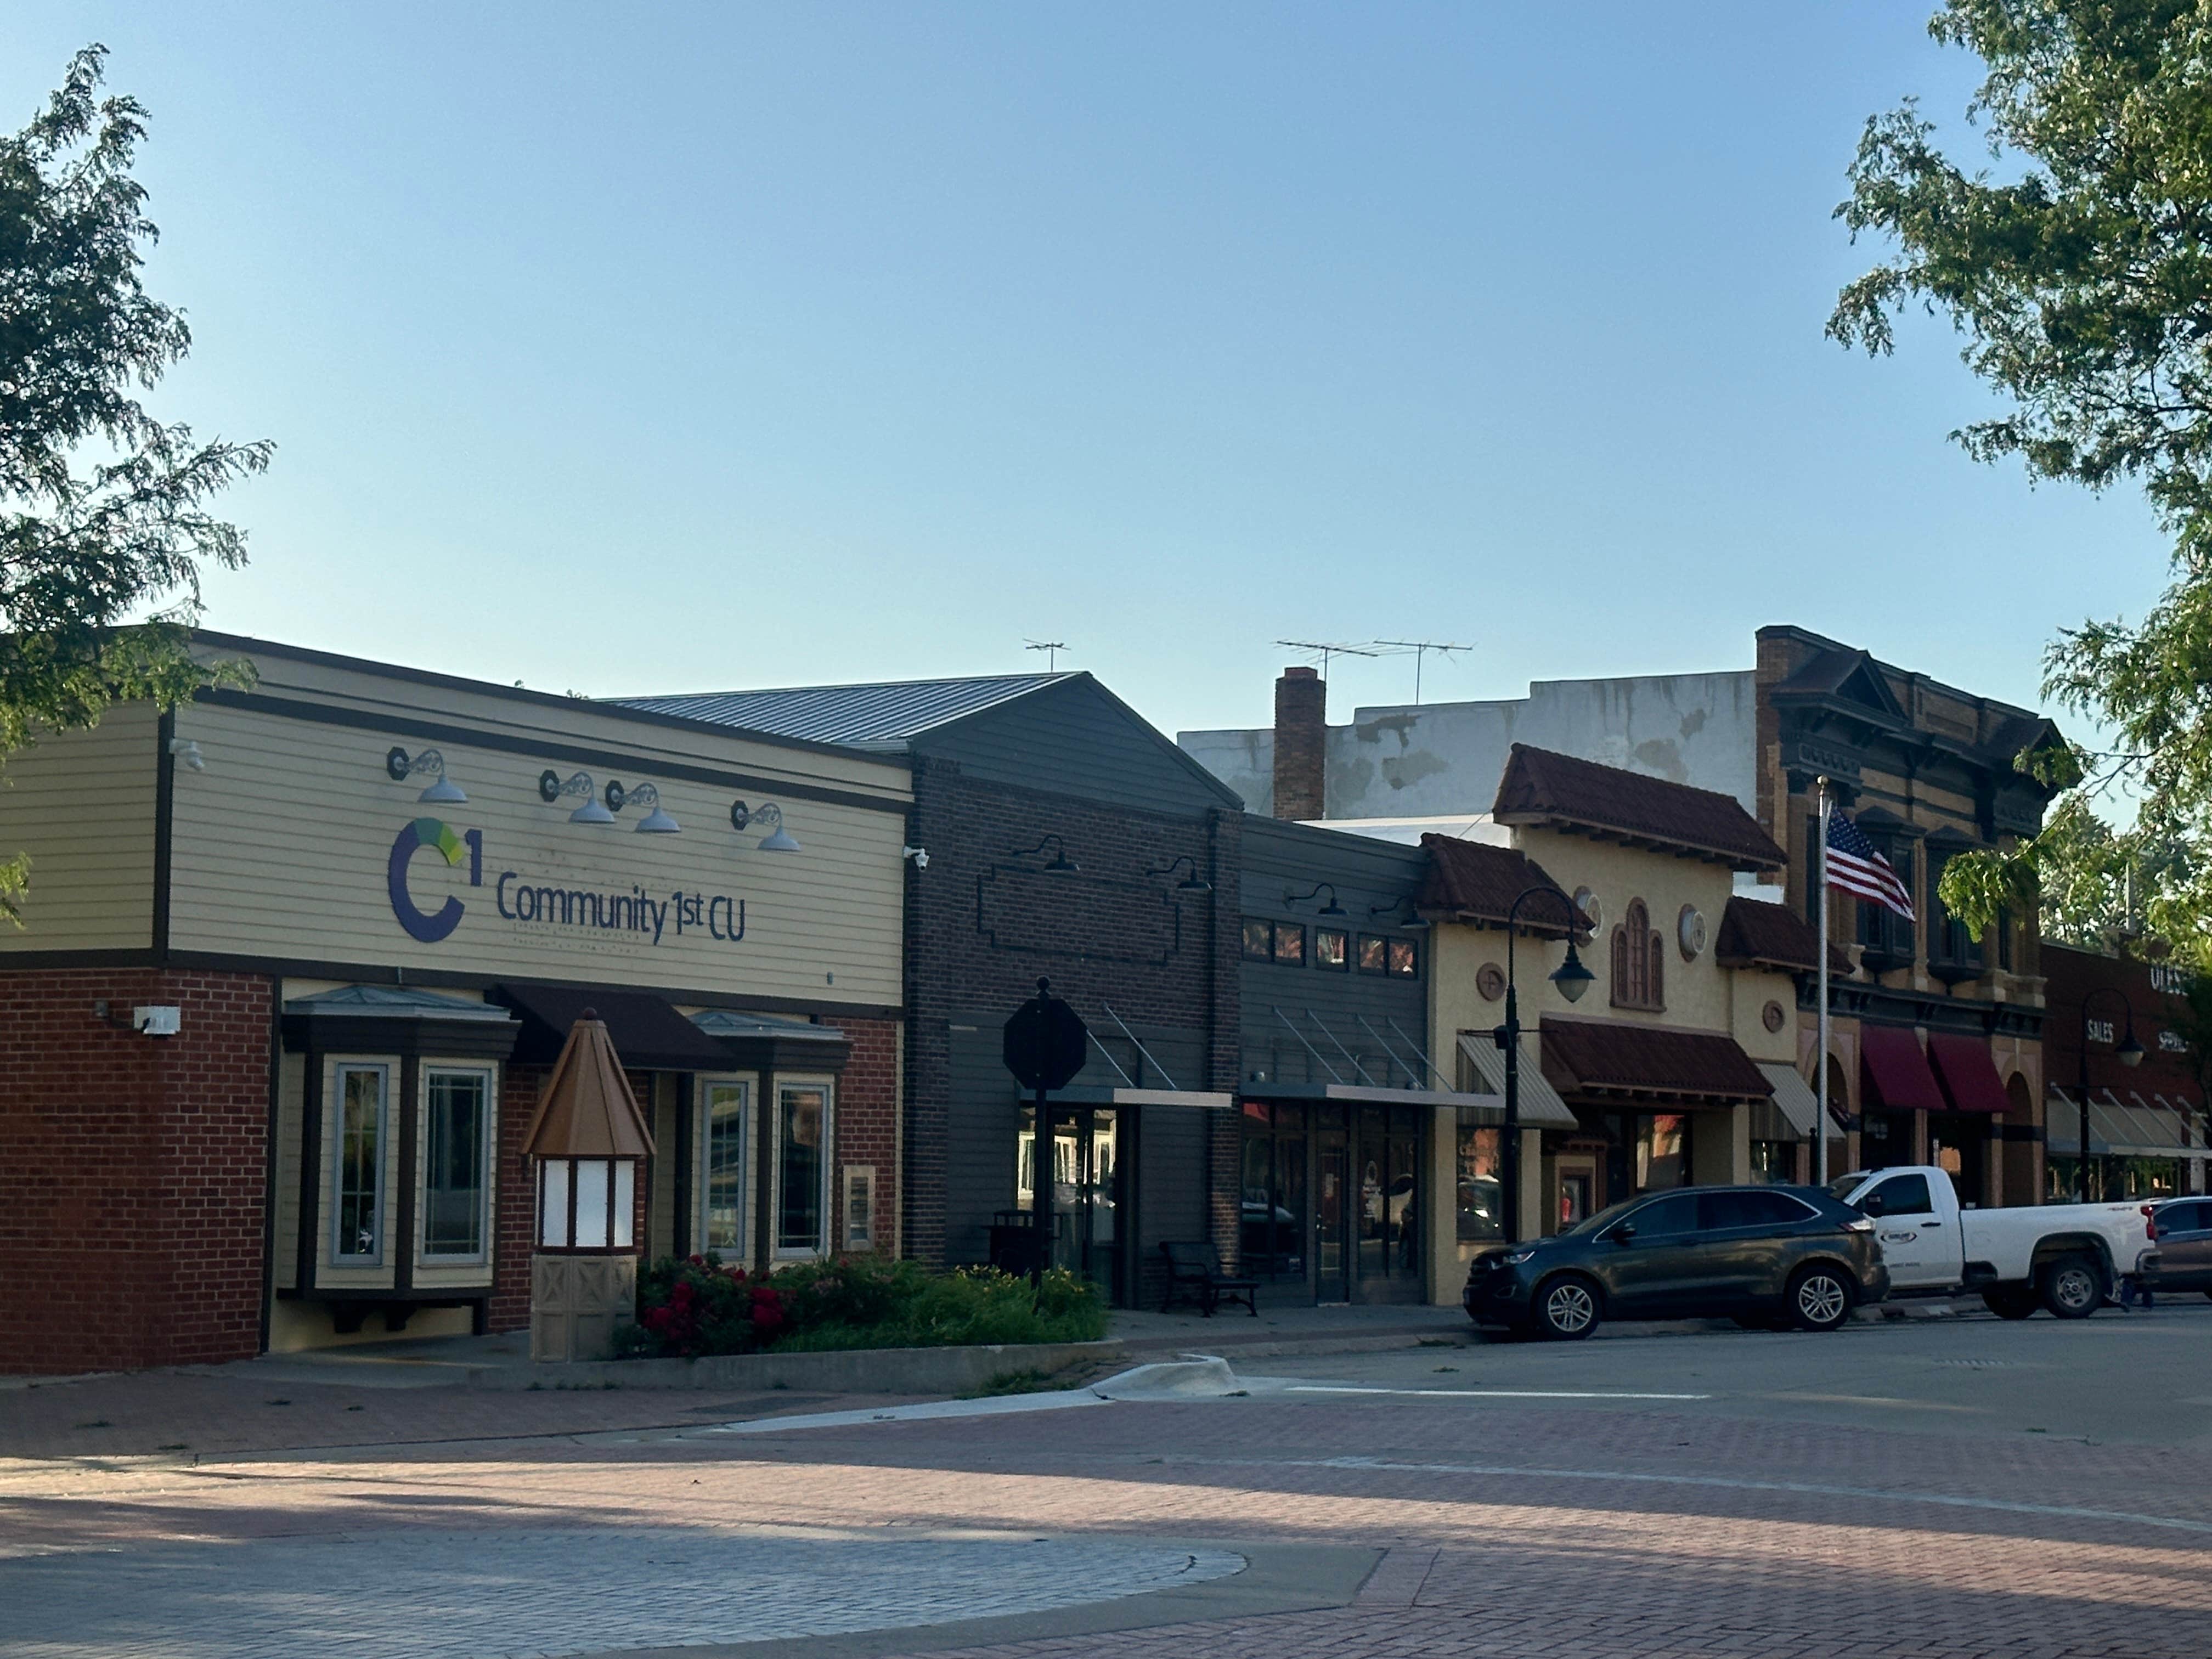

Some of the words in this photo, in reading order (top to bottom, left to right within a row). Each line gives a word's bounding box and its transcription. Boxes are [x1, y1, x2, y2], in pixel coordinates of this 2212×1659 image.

[498, 871, 667, 946] Community
[672, 891, 704, 935] 1st
[710, 896, 746, 942] CU
[2088, 1019, 2114, 1043] SALES
